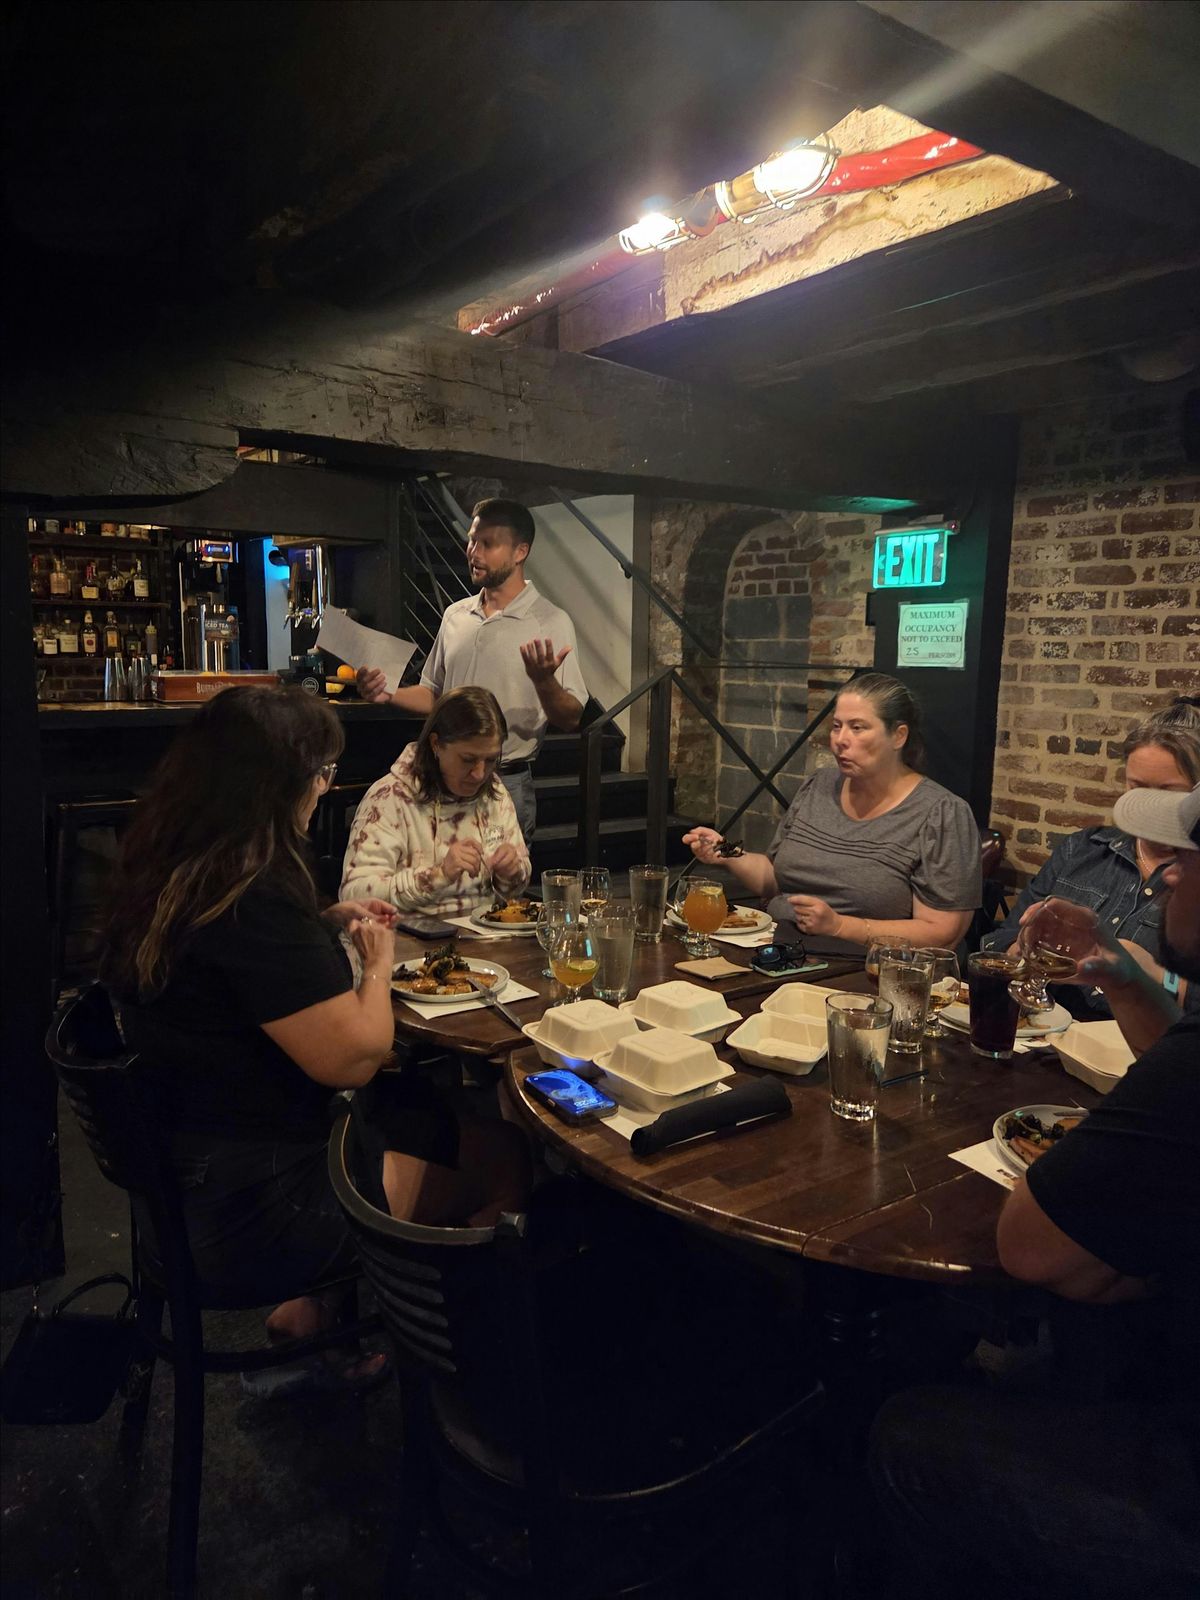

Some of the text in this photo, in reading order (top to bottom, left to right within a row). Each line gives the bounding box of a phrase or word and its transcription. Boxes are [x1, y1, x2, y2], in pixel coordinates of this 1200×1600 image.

[884, 533, 939, 585] EXIT
[910, 610, 955, 619] MAXIMUM
[904, 624, 956, 632] OCCUPANCY
[930, 635, 962, 643] EXCEED
